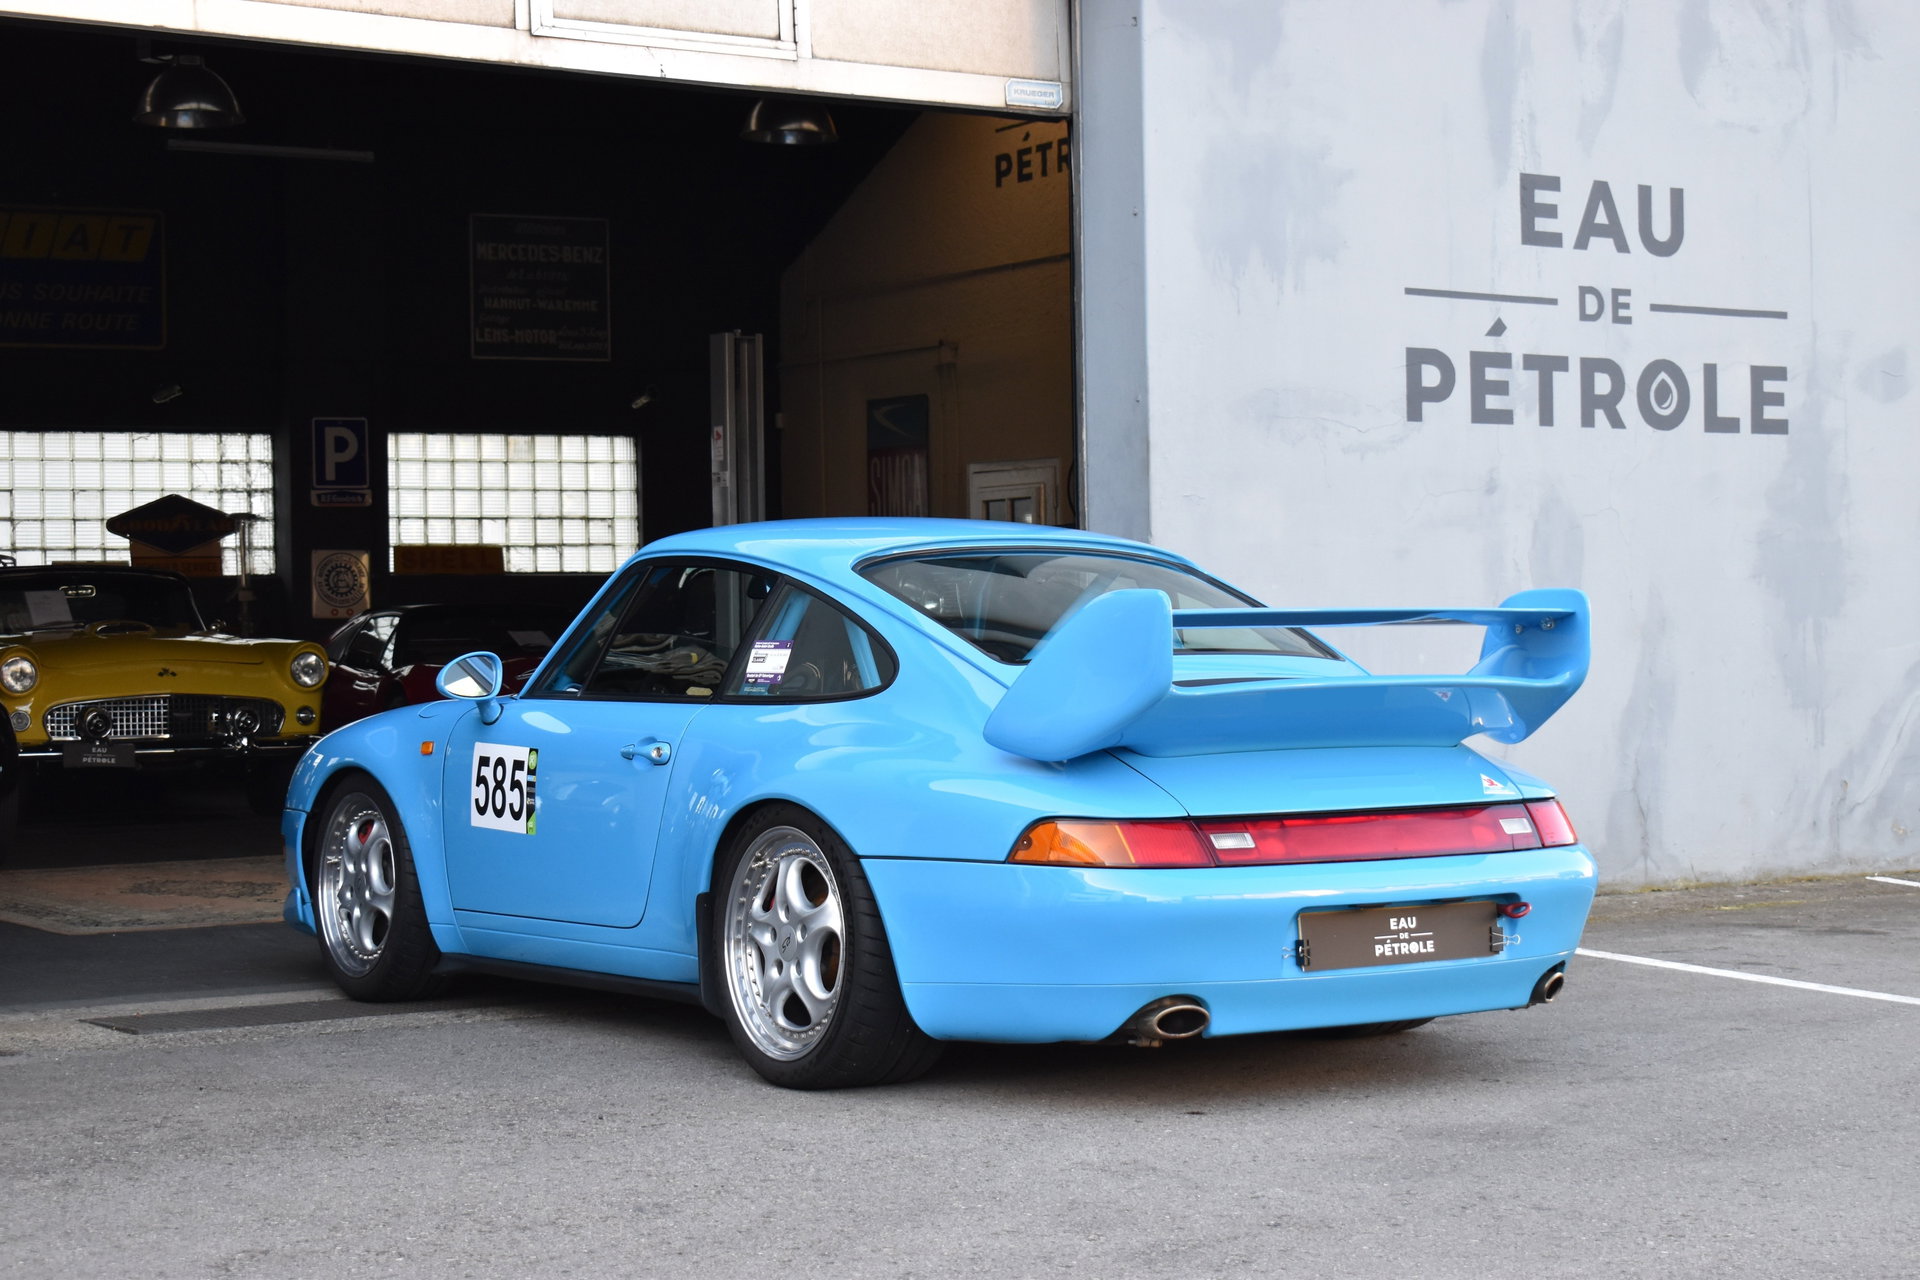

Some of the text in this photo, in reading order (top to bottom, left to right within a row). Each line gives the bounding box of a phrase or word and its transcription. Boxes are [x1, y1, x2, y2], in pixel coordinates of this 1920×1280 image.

[1013, 88, 1055, 98] KRUEGER
[1519, 172, 1684, 257] EAU
[33, 282, 153, 304] SOUHAITE
[1578, 285, 1633, 325] DE
[0, 310, 141, 331] NNE ROUTE
[1405, 316, 1789, 435] PÉTROLE
[324, 426, 359, 482] P
[871, 454, 923, 517] SIMCA
[400, 549, 496, 569] SHELL
[82, 756, 116, 764] PÉTROLE
[474, 755, 526, 821] 585
[1389, 916, 1417, 930] EAU
[1399, 932, 1409, 940] DE
[1374, 939, 1435, 957] PÉTROLE
